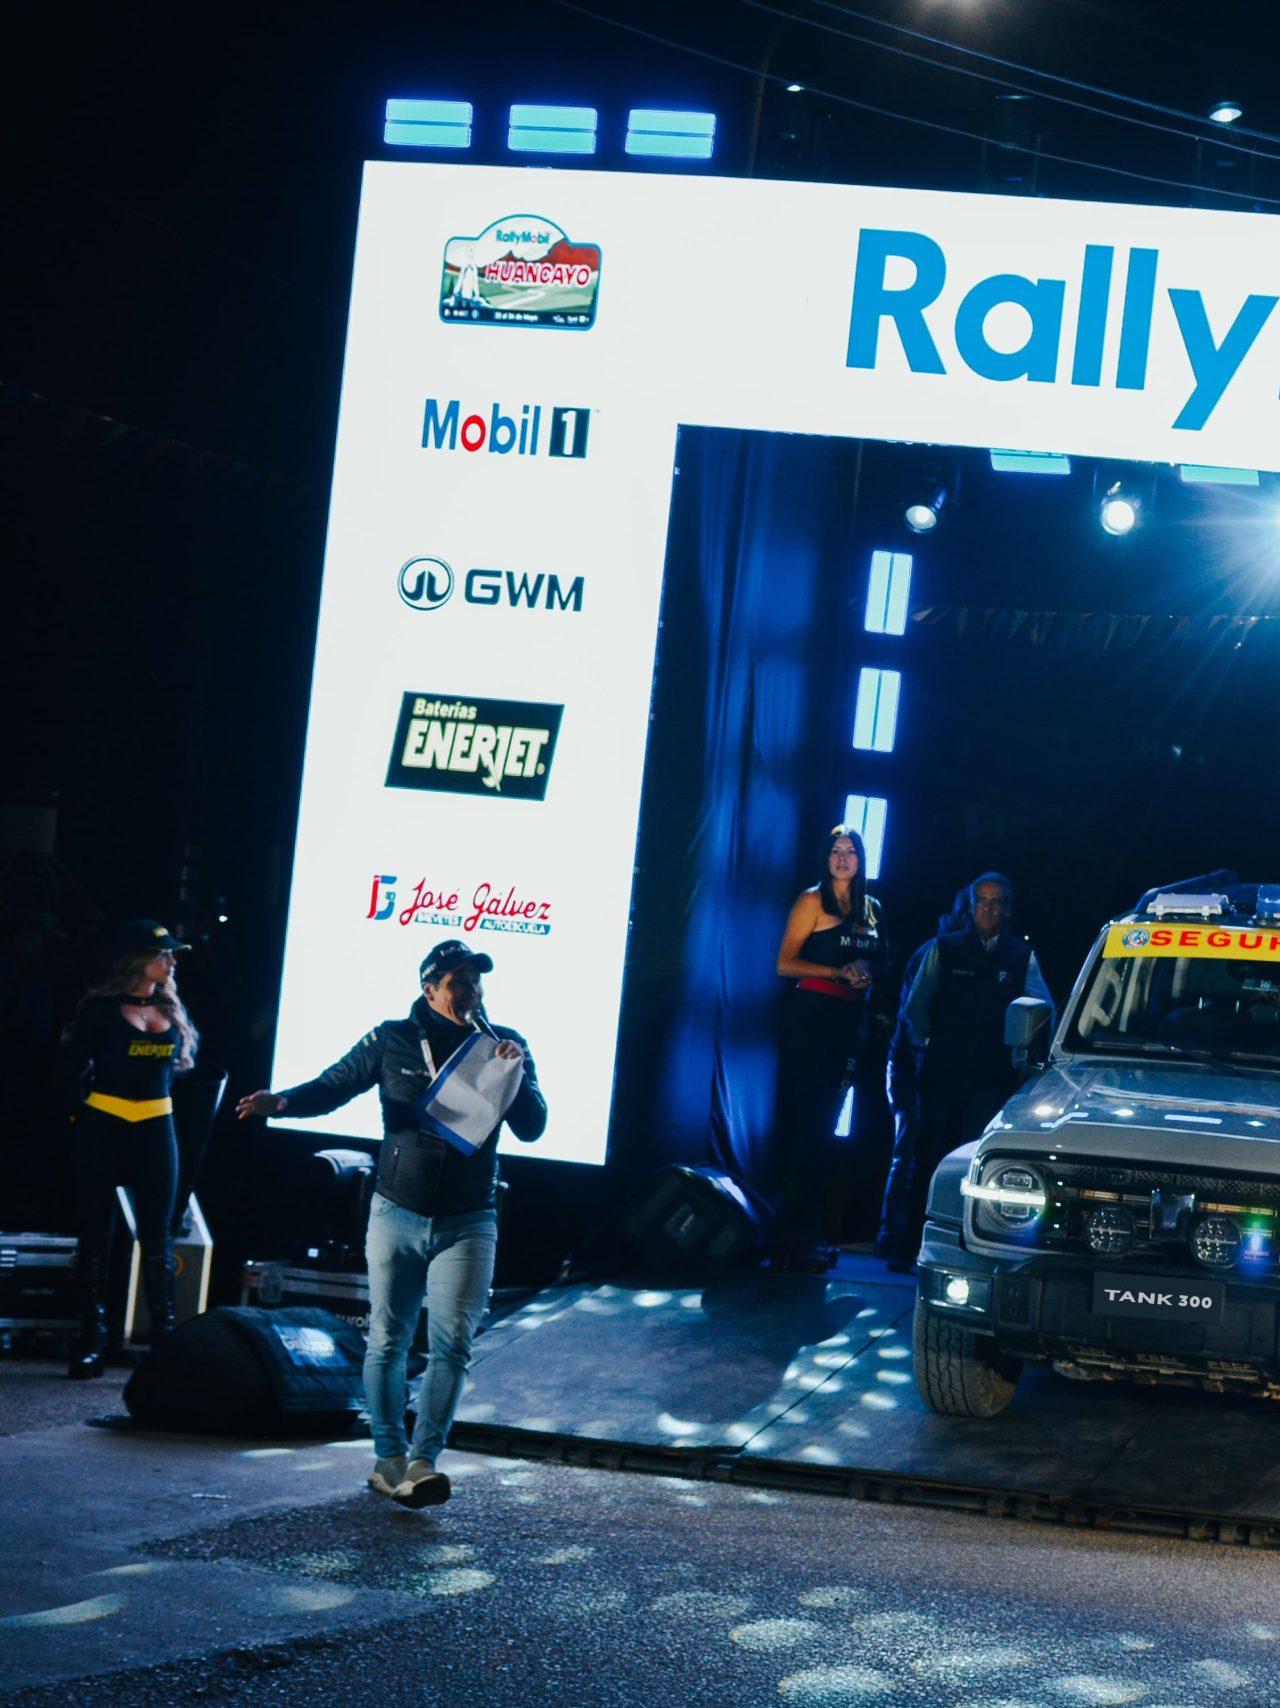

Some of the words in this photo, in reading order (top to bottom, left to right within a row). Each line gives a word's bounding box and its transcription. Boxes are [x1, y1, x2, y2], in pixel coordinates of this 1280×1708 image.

[496, 229, 550, 246] RallyMobil
[485, 262, 591, 286] HUANCAYO
[421, 398, 541, 456] Mobil
[464, 568, 585, 612] GWM
[399, 876, 461, 926] José
[463, 882, 552, 932] Gálvez
[1103, 1288, 1174, 1306] TANK
[1178, 1294, 1213, 1309] 300
